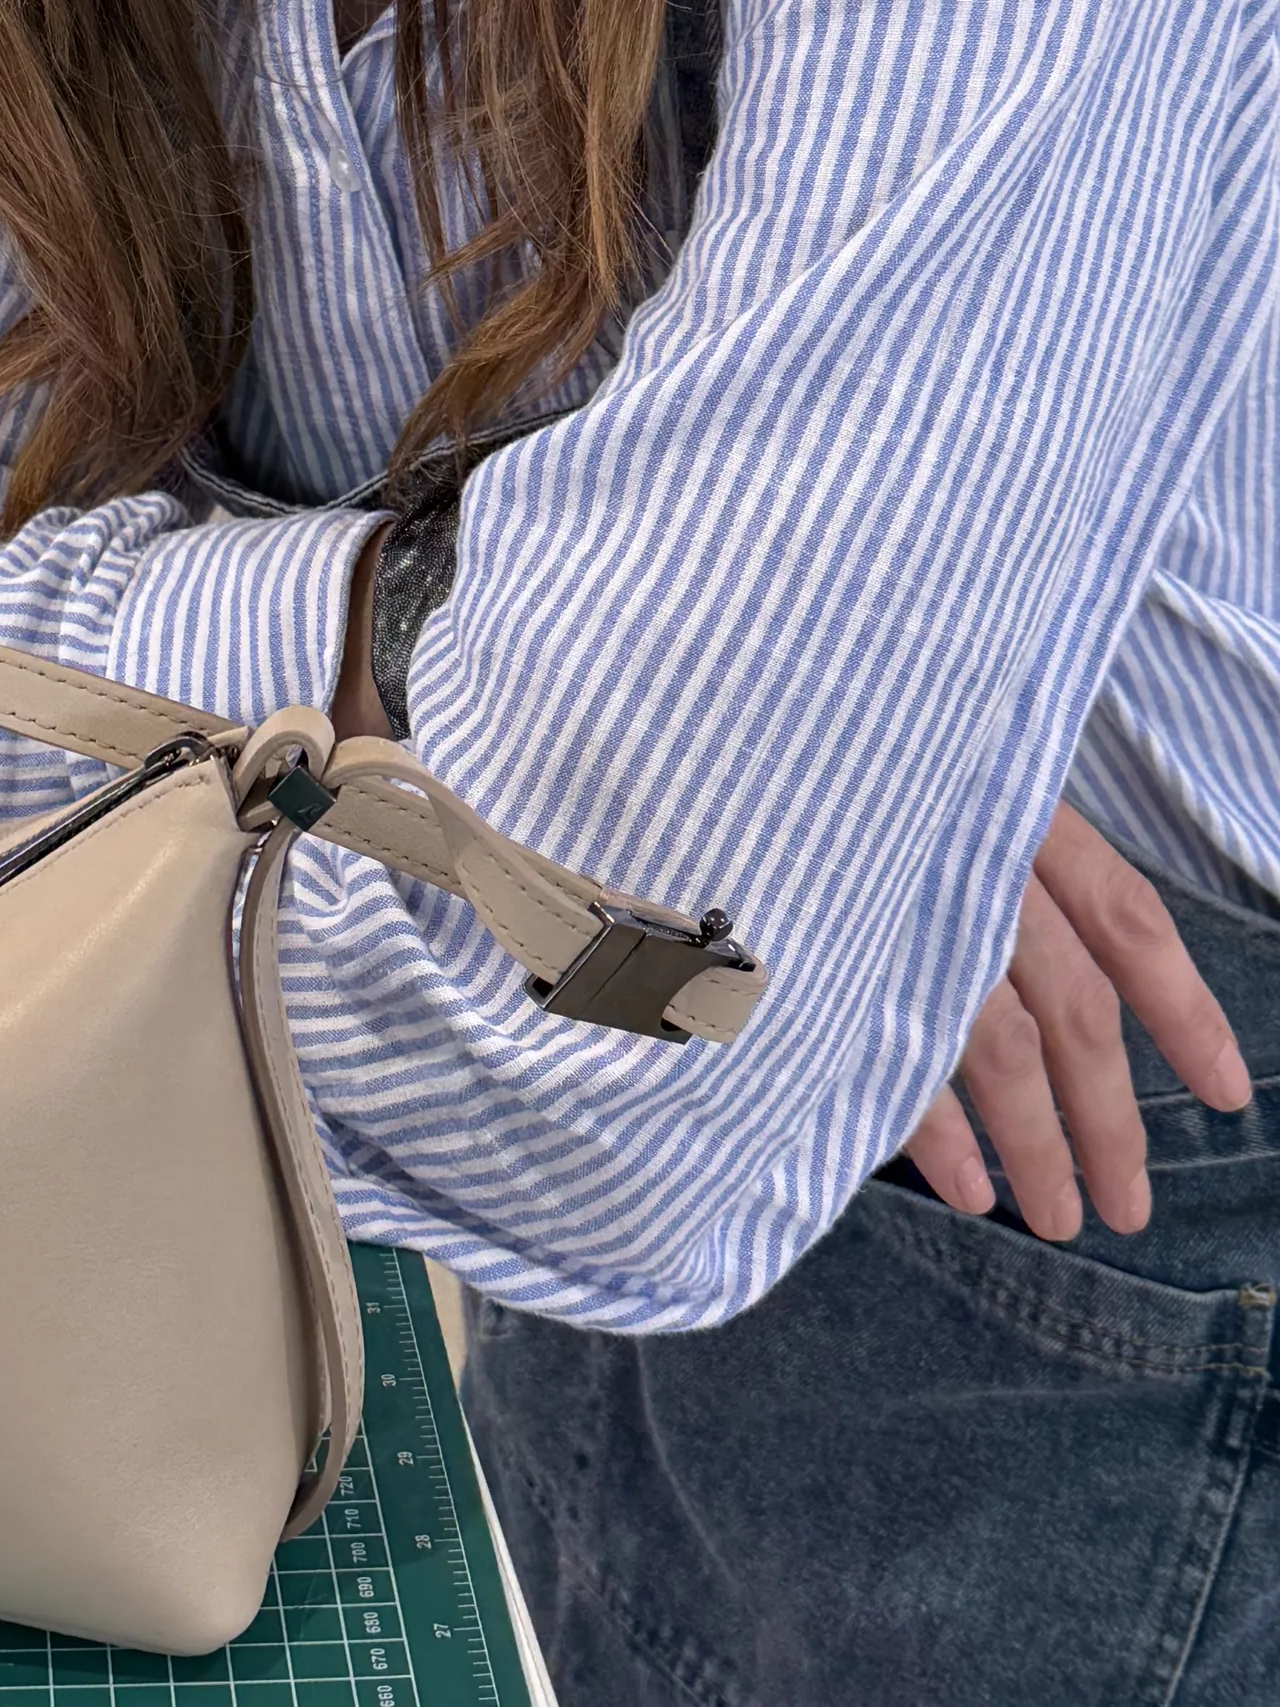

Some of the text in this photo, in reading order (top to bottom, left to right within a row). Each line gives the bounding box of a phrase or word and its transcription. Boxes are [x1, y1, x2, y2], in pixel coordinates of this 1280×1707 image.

[365, 1302, 381, 1314] 31
[380, 1373, 397, 1387] 30
[397, 1451, 414, 1466] 29
[339, 1475, 354, 1496] 720
[344, 1508, 361, 1529] 710
[414, 1534, 432, 1549] 28
[350, 1542, 368, 1564] 700
[357, 1576, 375, 1598] 690
[363, 1611, 382, 1634] 680
[433, 1623, 452, 1638] 27
[369, 1647, 388, 1670] 670
[376, 1684, 396, 1707] 660
